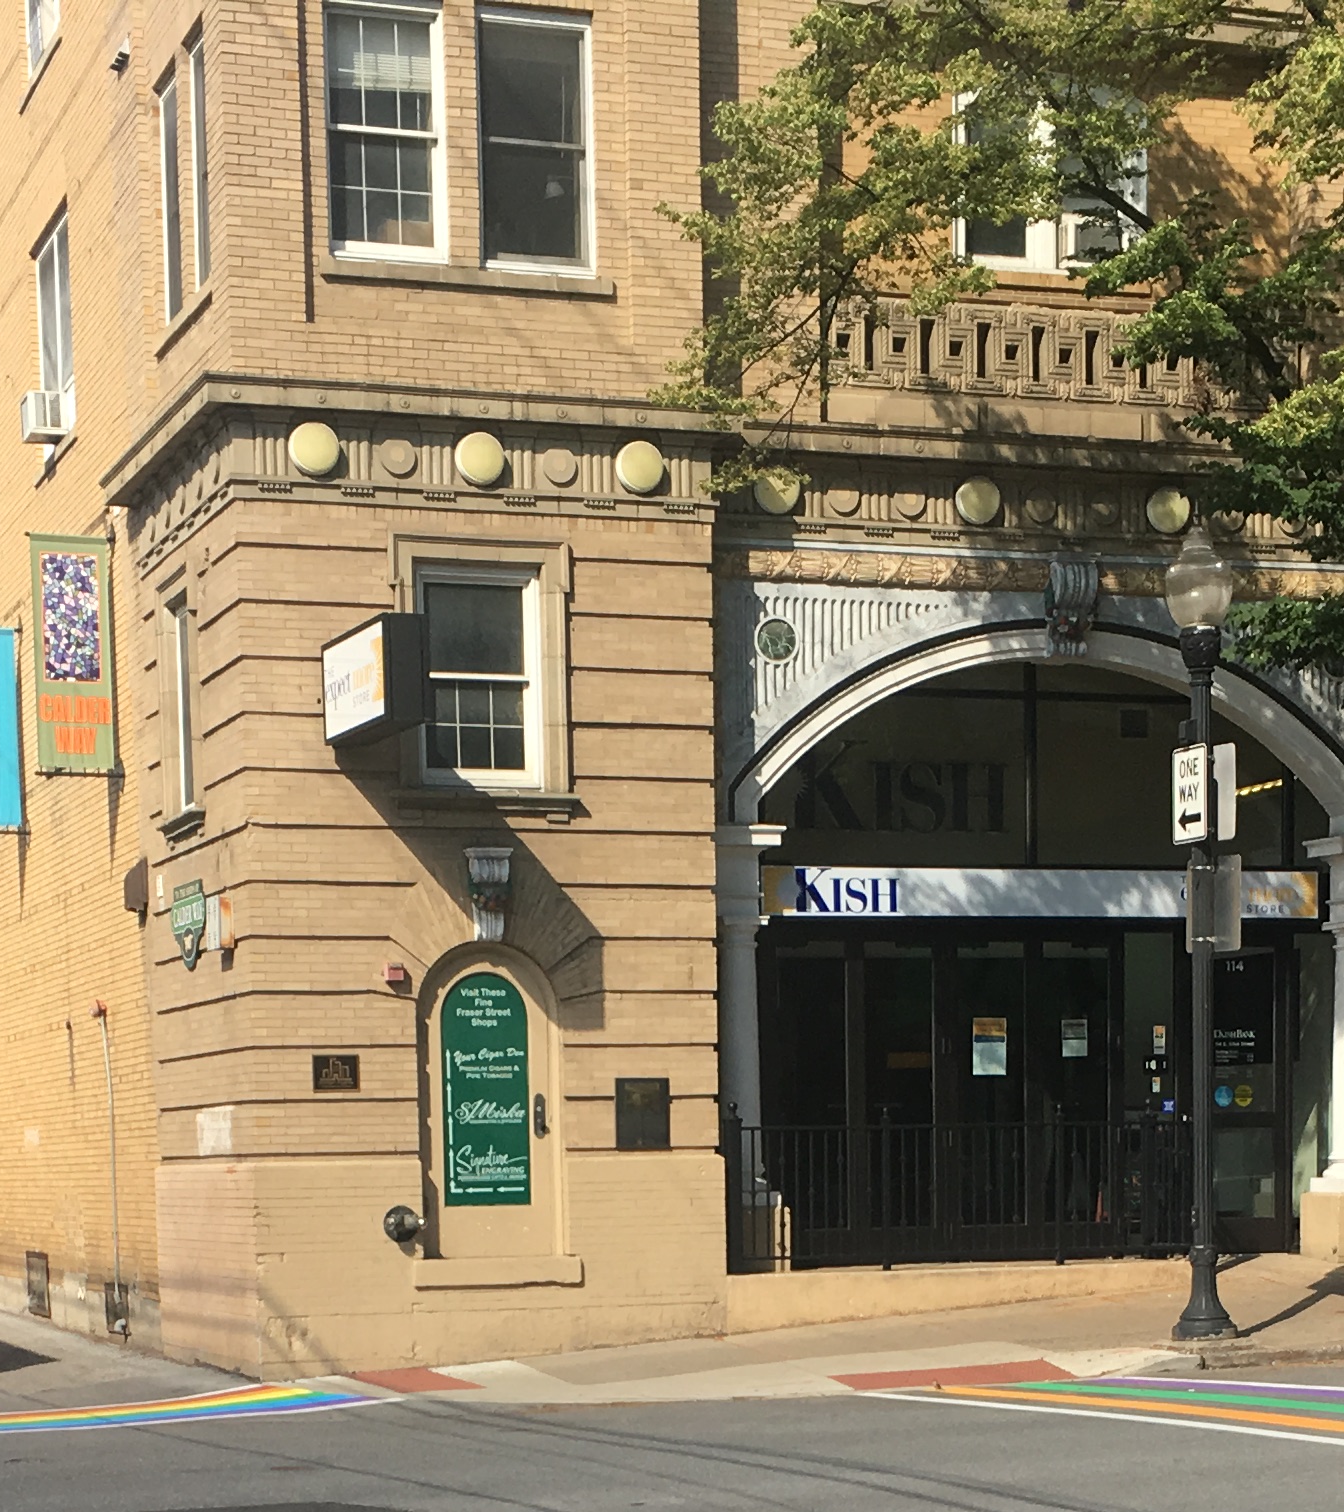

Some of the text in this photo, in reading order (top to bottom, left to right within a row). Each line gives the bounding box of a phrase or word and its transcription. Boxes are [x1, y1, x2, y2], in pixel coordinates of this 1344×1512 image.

[39, 692, 111, 725] CALDER
[54, 725, 97, 755] WAY
[1179, 757, 1199, 779] ONE
[793, 740, 1009, 834] KISH
[1179, 782, 1200, 804] WAY
[794, 867, 900, 914] KISH
[1246, 904, 1285, 914] STORE
[1225, 961, 1244, 972] 114
[460, 988, 506, 997] Visit These
[474, 998, 493, 1007] Fine
[456, 1007, 511, 1017] Fraser Street
[471, 1017, 498, 1027] Shops
[453, 1050, 477, 1067] Your
[477, 1047, 504, 1062] Cigar
[456, 1144, 528, 1177] Signature
[481, 1166, 525, 1174] ENGRAVING
